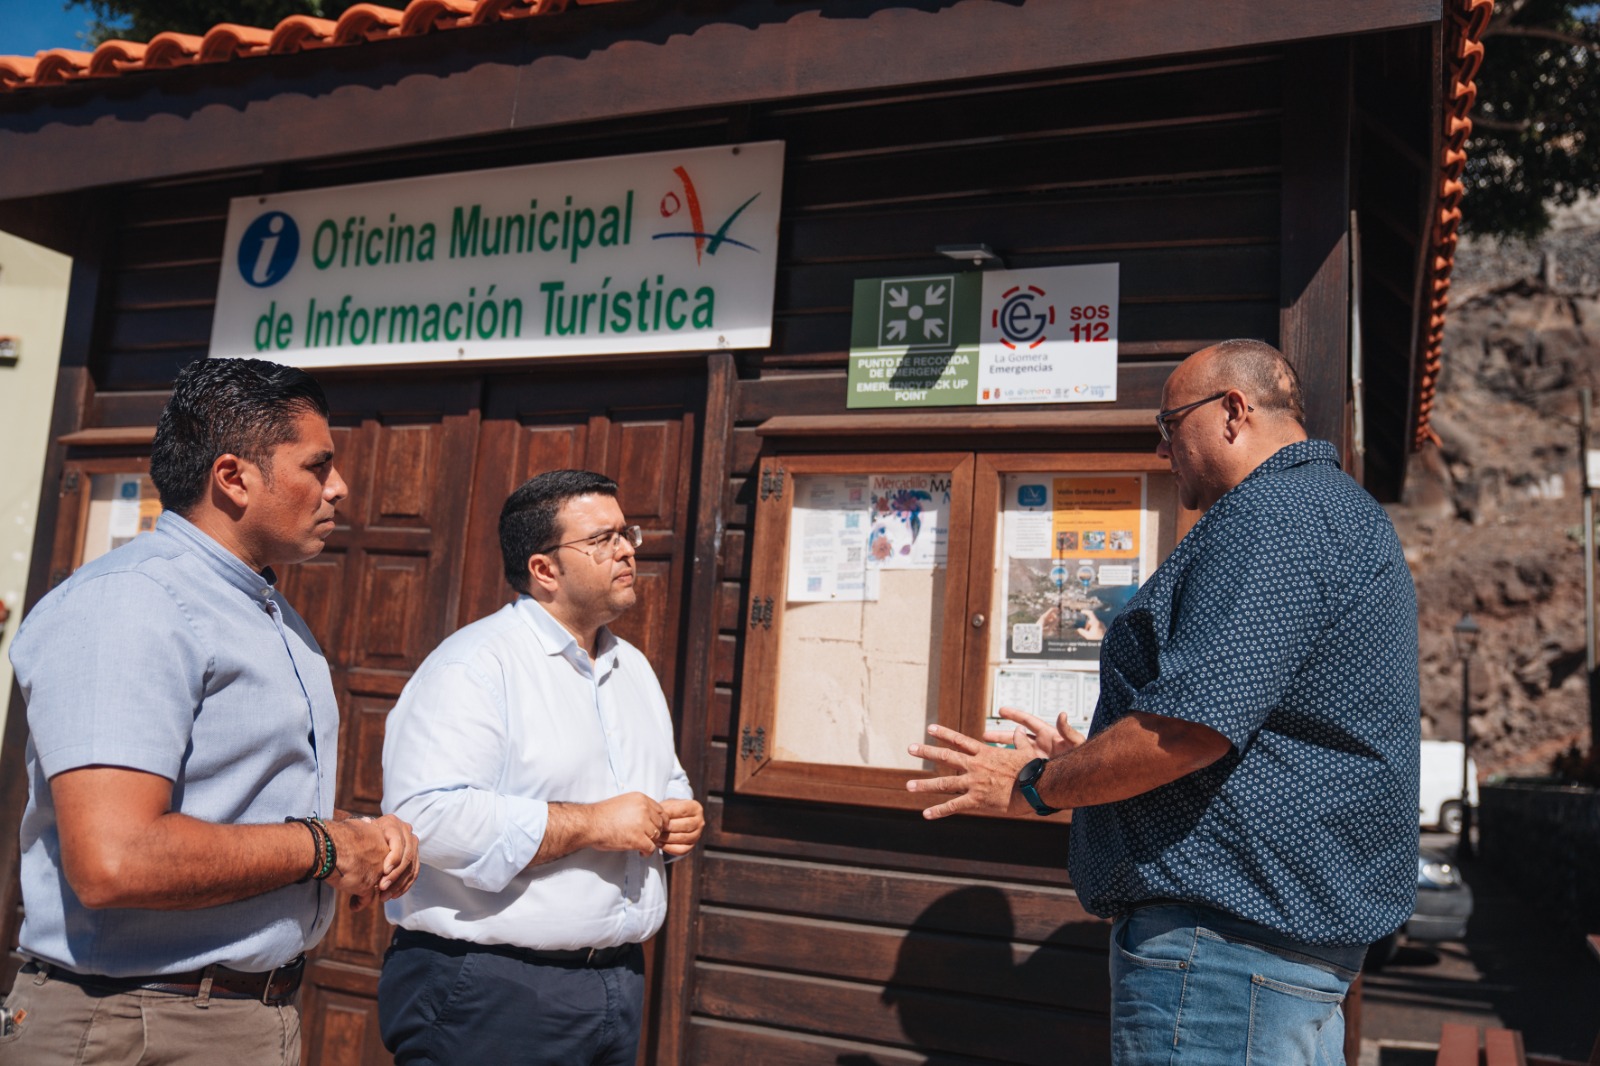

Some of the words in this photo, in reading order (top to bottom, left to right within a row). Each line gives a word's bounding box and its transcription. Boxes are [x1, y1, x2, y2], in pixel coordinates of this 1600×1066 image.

[312, 213, 435, 270] Oficina
[449, 190, 634, 263] Municipal
[254, 301, 293, 351] de
[305, 285, 524, 348] Información
[539, 274, 716, 337] Turística
[1069, 304, 1110, 320] SOS
[1069, 322, 1109, 343] 112
[858, 357, 894, 368] PUNTO
[896, 356, 911, 367] DE
[913, 355, 970, 366] RECOGIDA
[994, 354, 1007, 364] La
[1010, 352, 1049, 363] Gomera
[869, 368, 884, 378] DE
[886, 365, 957, 377] EMERGENCIA
[989, 363, 1053, 376] Emergencias
[856, 380, 923, 393] EMERGENCY
[925, 379, 951, 390] PICK
[952, 379, 968, 389] UP
[895, 391, 928, 402] POINT
[874, 476, 928, 490] Mercadillo
